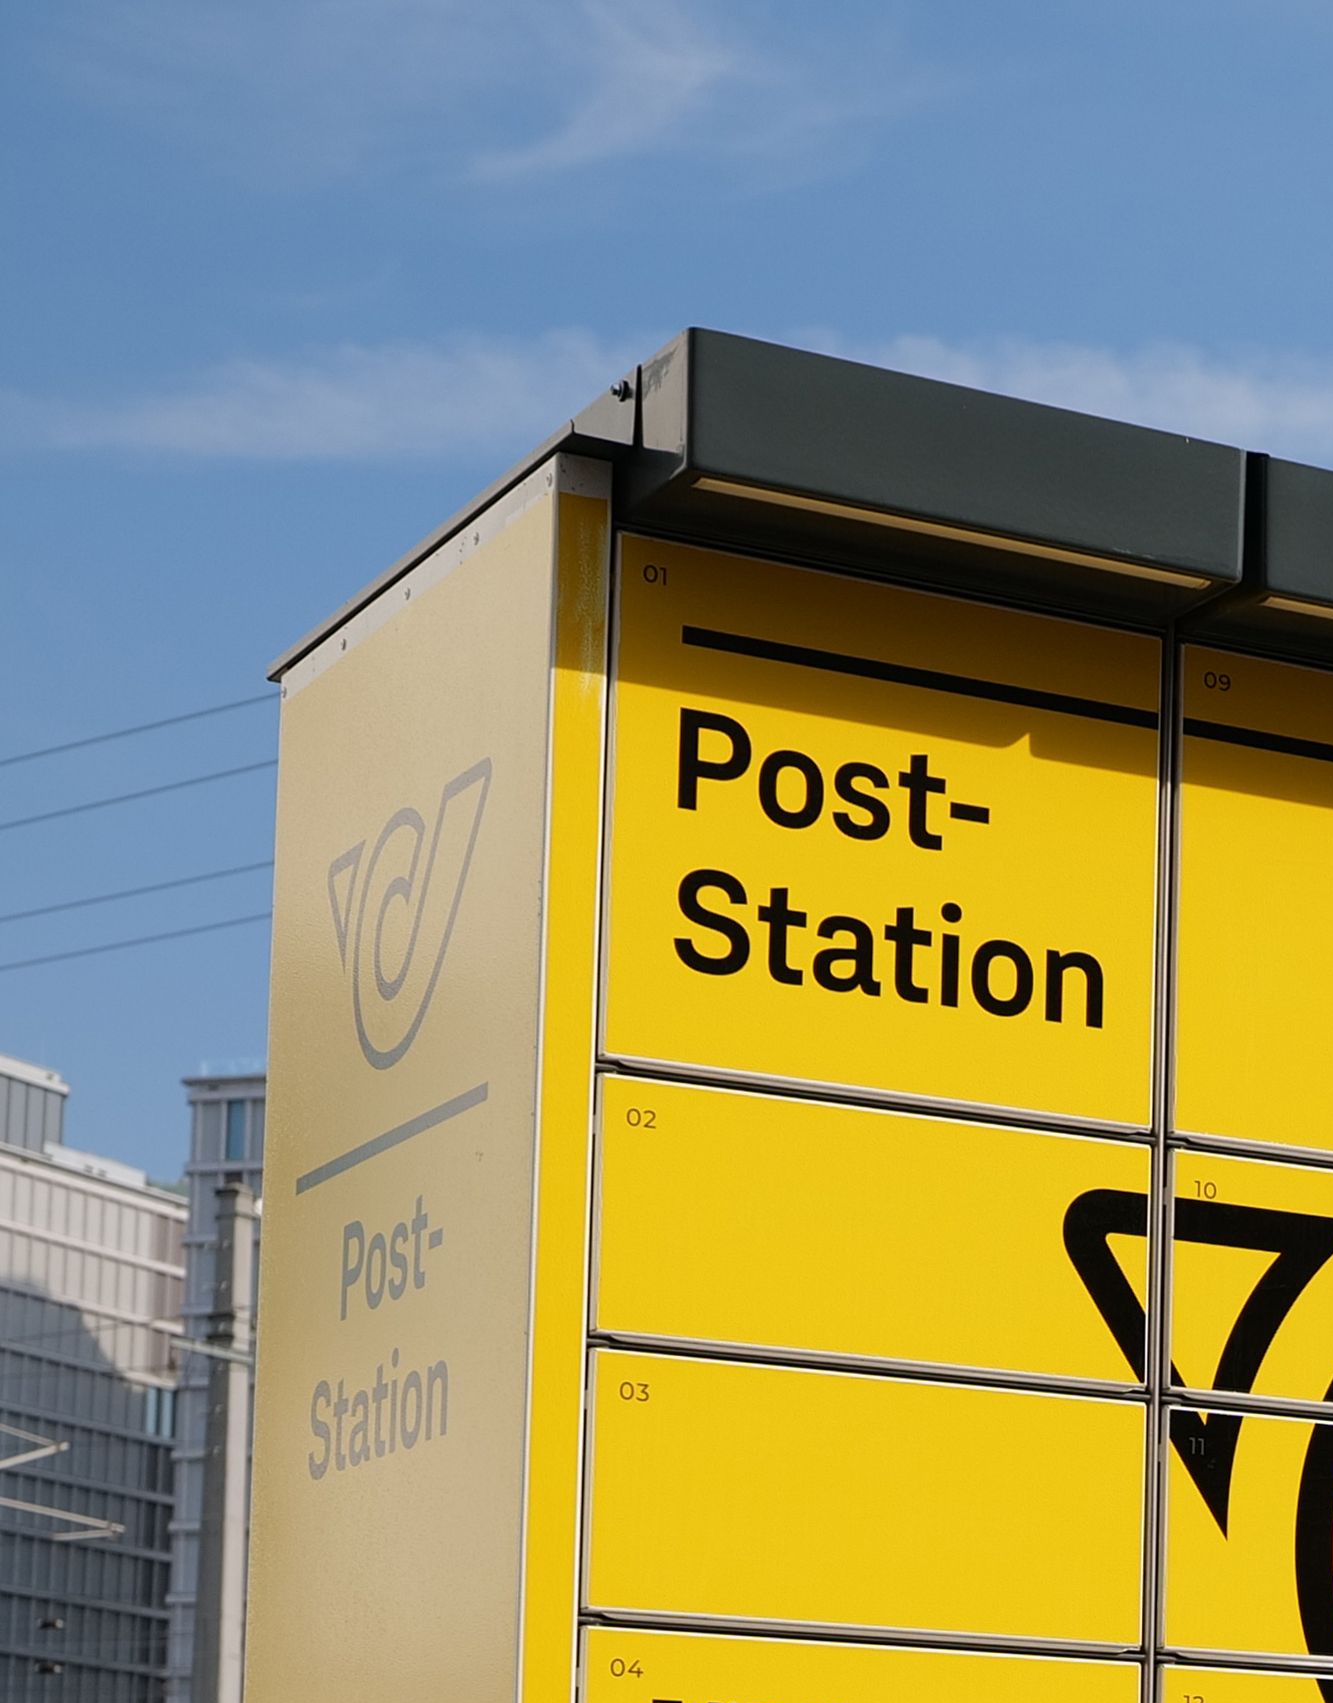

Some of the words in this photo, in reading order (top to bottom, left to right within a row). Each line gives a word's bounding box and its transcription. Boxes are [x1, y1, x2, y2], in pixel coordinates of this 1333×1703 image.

[643, 565, 667, 585] 01
[1203, 672, 1231, 691] 09
[675, 706, 992, 853] Post-
[674, 869, 1103, 1028] Station
[627, 1107, 656, 1128] 02
[1193, 1181, 1216, 1200] 10
[340, 1195, 445, 1321] Post-
[620, 1382, 649, 1401] 03
[307, 1348, 450, 1481] Station
[1189, 1437, 1204, 1455] 11
[611, 1659, 643, 1678] 04
